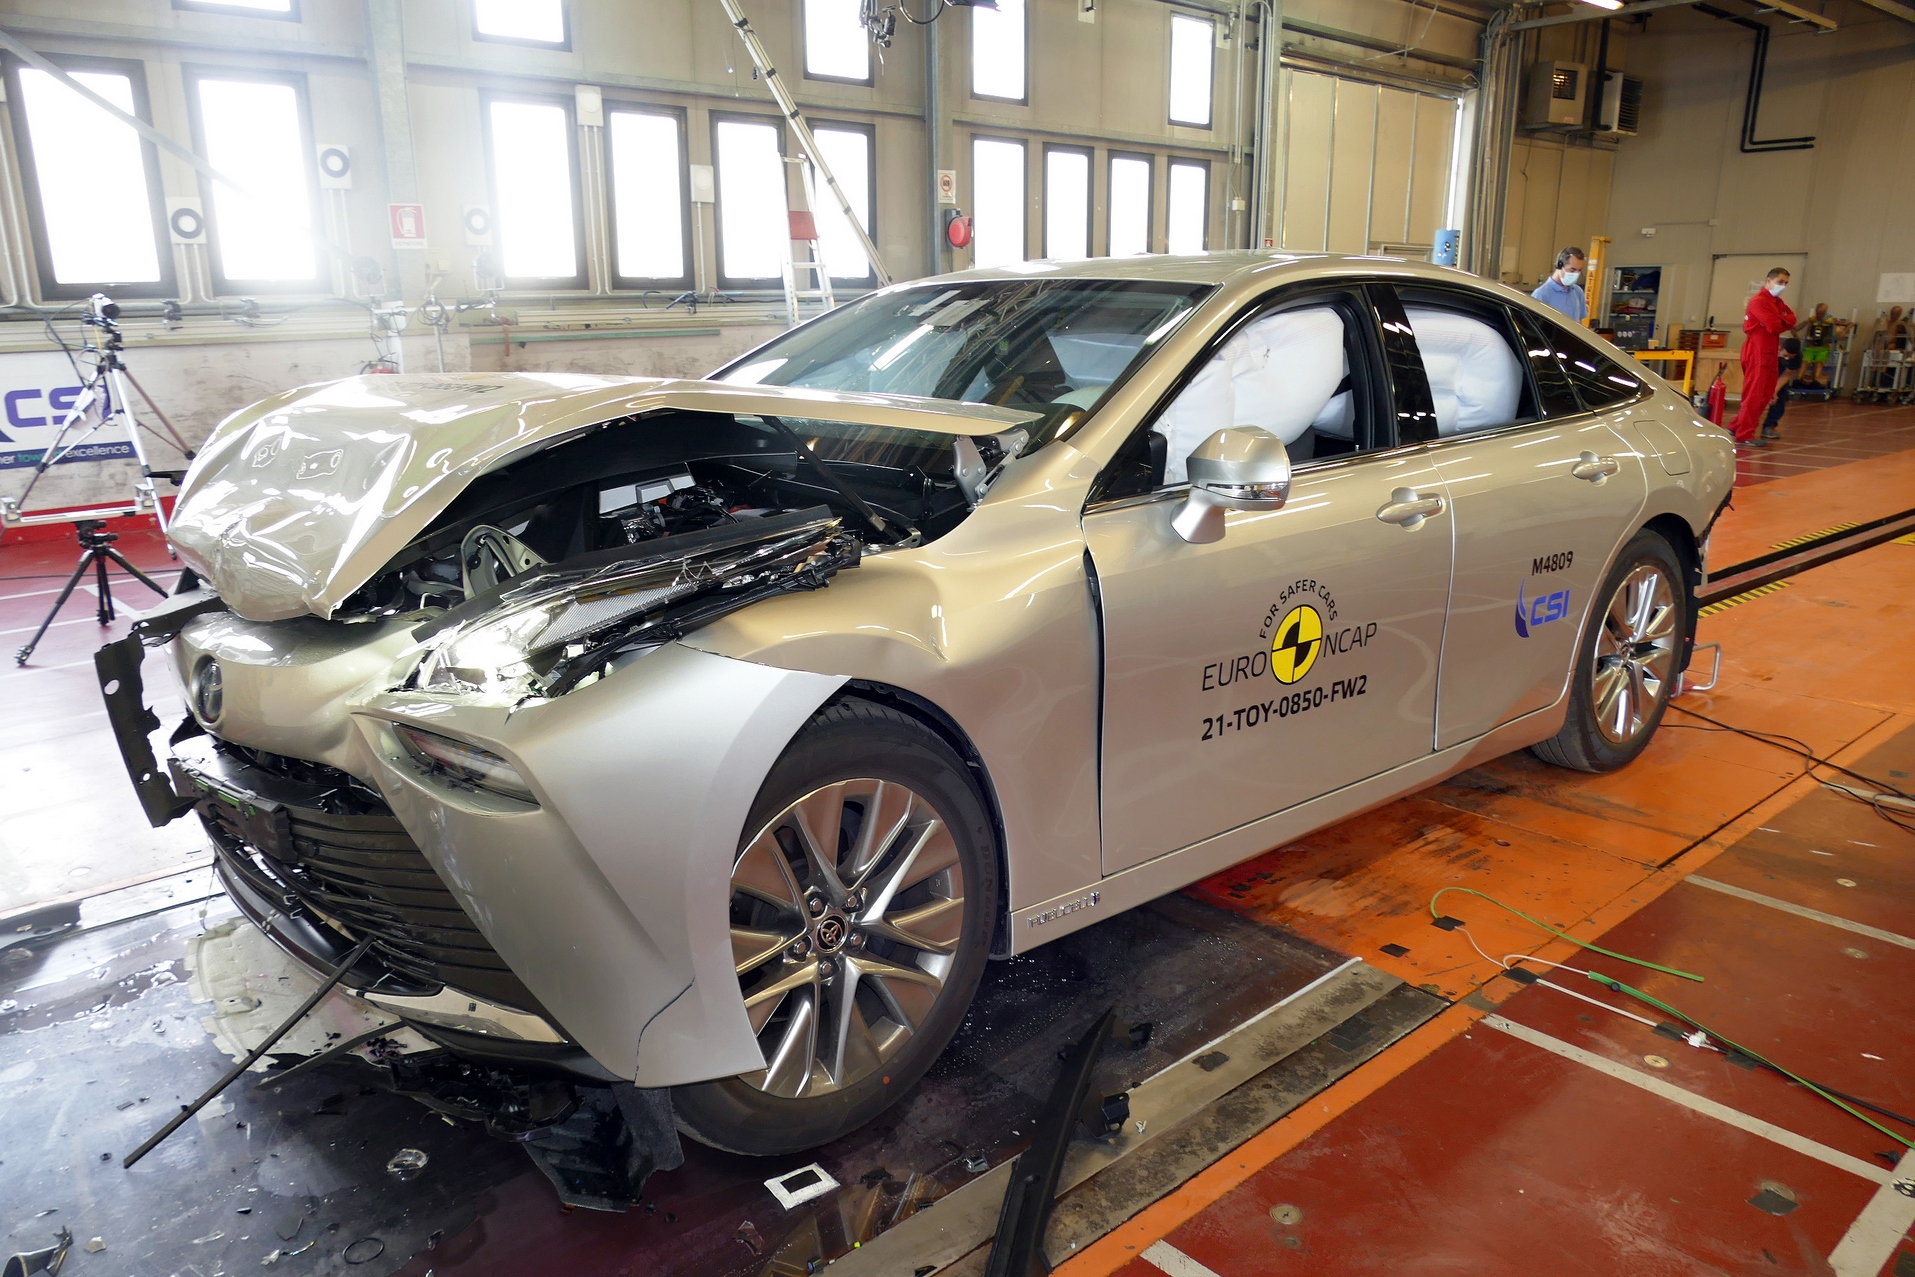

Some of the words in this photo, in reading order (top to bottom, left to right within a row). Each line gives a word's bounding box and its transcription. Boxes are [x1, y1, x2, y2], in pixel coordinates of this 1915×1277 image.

[65, 445, 130, 458] excellence
[1532, 551, 1573, 576] M4809
[1259, 603, 1279, 639] FOR
[1280, 579, 1316, 604] SAFER
[1318, 585, 1338, 622] CARS
[1530, 590, 1570, 627] CSI
[1202, 651, 1267, 691] EURO
[1323, 622, 1377, 657] NCAP
[1201, 675, 1367, 741] 21-TOY-0850-FW2
